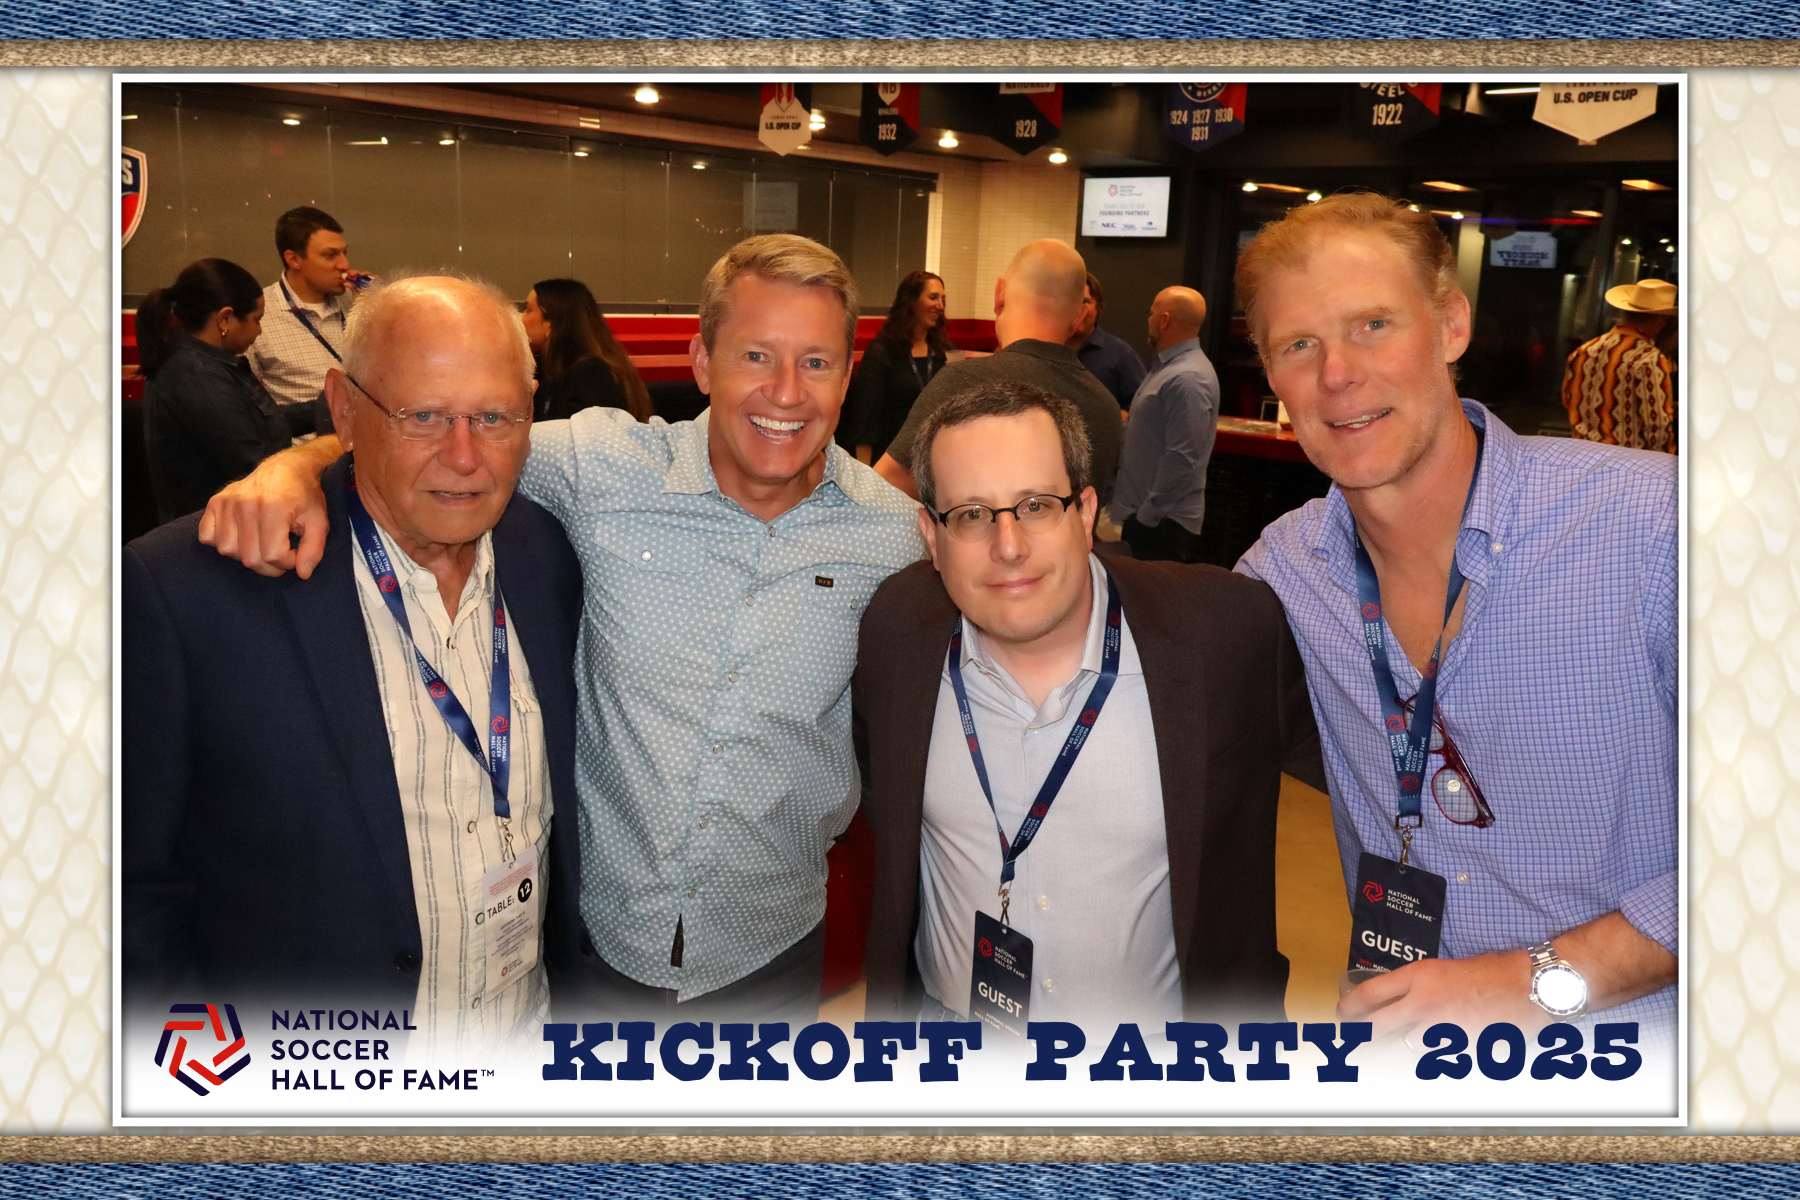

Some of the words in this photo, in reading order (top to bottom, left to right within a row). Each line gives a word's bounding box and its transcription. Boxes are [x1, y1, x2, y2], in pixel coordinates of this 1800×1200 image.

[1553, 92, 1575, 104] U.S.
[1578, 91, 1610, 103] OPEN
[1613, 88, 1638, 101] CUP
[1193, 109, 1211, 124] 1927
[1215, 107, 1234, 123] 1930
[1372, 103, 1403, 125] 1922
[878, 123, 897, 141] 1932
[1015, 119, 1037, 138] 1928
[1191, 126, 1209, 141] 1931
[1370, 623, 1378, 645] SOCCER
[1375, 622, 1383, 649] NATIONAL
[490, 750, 496, 758] OF
[1393, 750, 1399, 758] OF
[1396, 734, 1405, 757] SOCCER
[1405, 744, 1413, 771] NATIONAL
[1418, 750, 1424, 759] OF
[520, 882, 531, 899] 12
[1387, 889, 1420, 905] NATIONAL
[487, 895, 514, 919] TABLE:
[1386, 901, 1403, 912] HALL
[1404, 908, 1414, 916] OF
[1387, 895, 1414, 909] SOCCER
[994, 945, 1017, 963] NATIONAL
[1361, 930, 1428, 962] GUEST
[994, 951, 1013, 966] SOCCER
[994, 957, 1006, 968] HALL
[978, 981, 1023, 1018] GUEST
